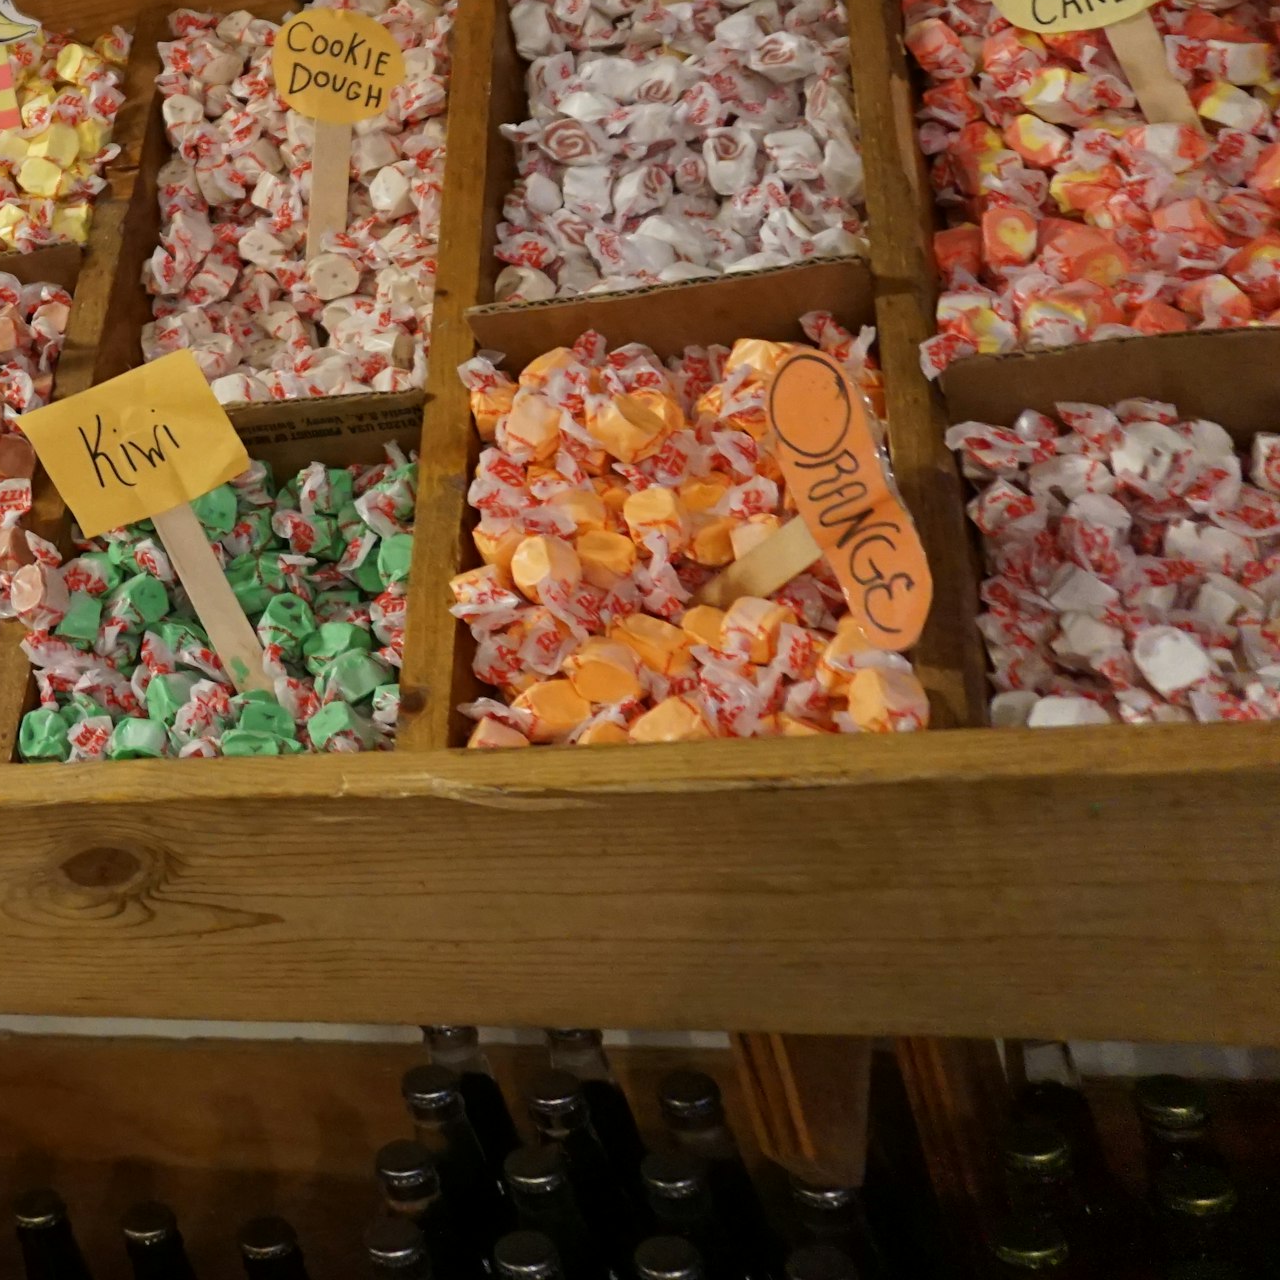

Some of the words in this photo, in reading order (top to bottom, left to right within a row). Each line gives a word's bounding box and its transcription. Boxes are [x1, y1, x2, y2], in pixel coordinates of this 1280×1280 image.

[286, 21, 391, 77] COOKIE
[288, 61, 383, 109] DOUGH
[77, 408, 181, 489] Kiwi
[768, 353, 916, 635] ORANGE
